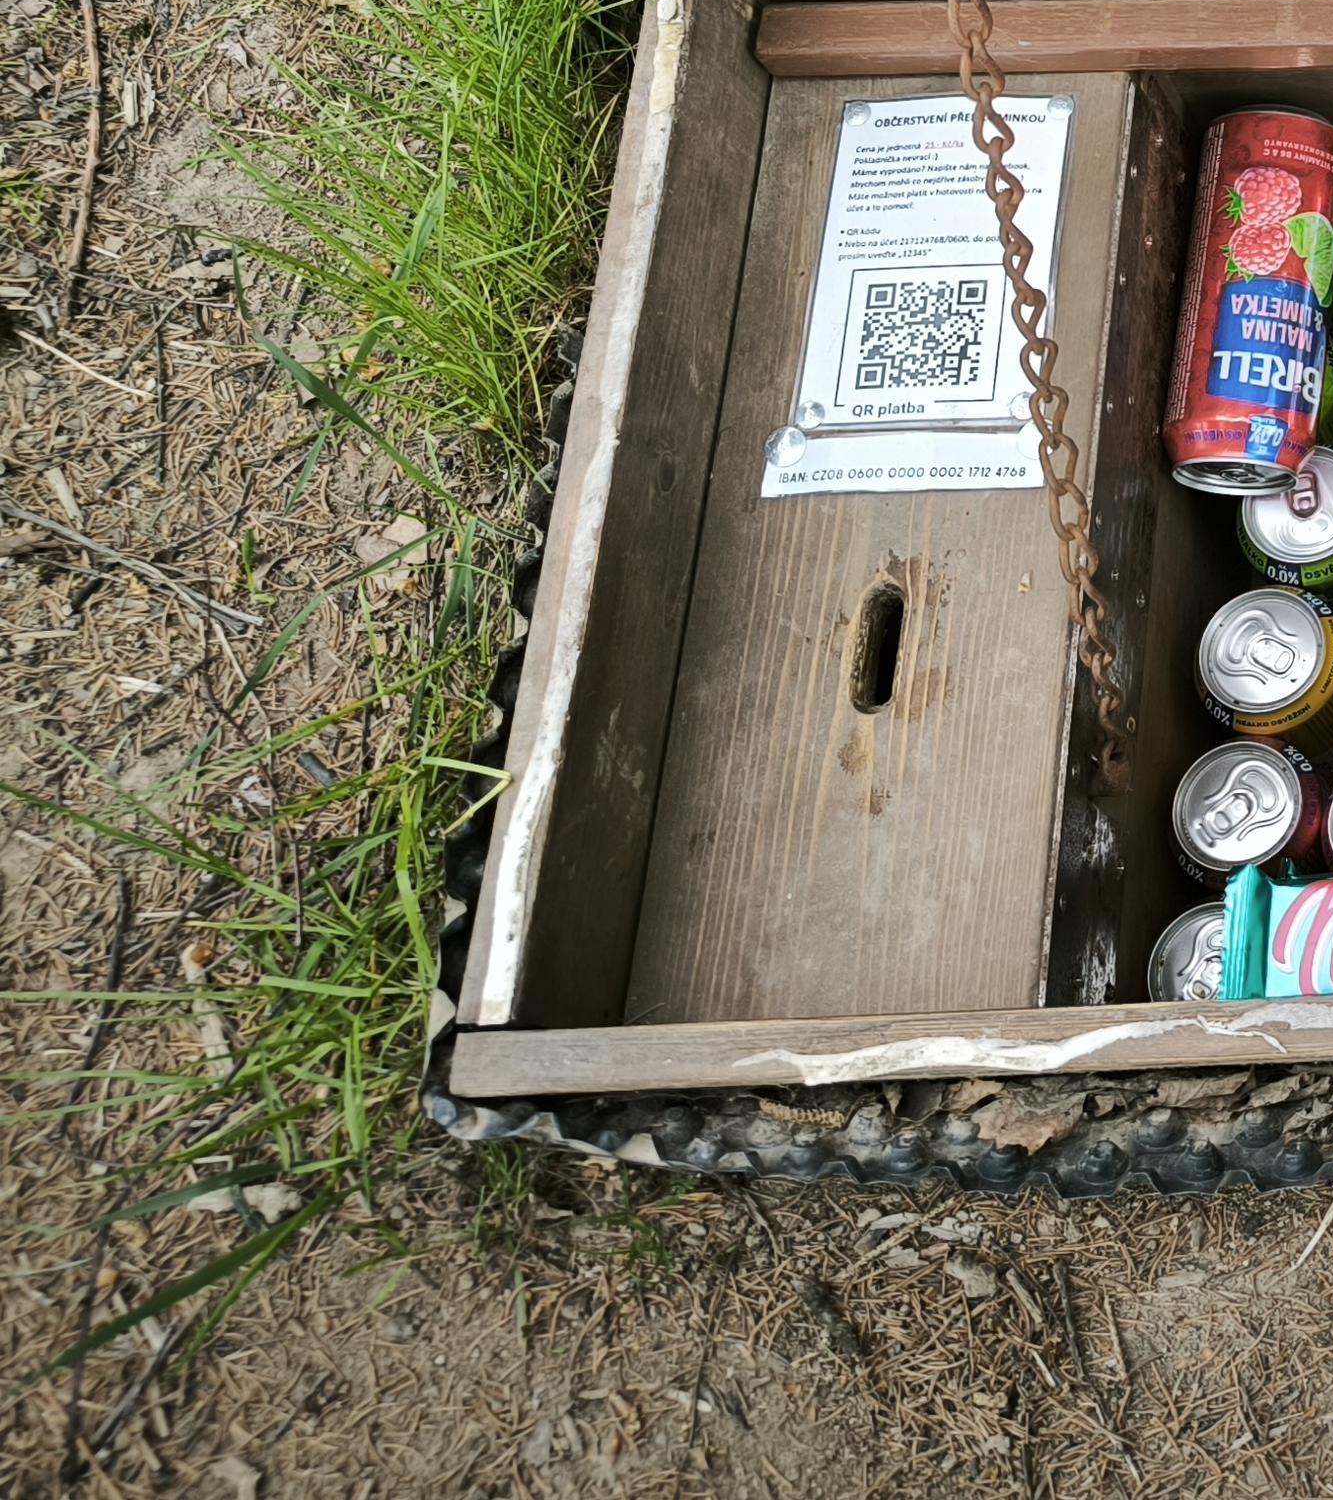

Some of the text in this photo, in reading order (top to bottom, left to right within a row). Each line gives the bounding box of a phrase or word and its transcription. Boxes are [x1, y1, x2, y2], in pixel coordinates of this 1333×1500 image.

[875, 111, 948, 128] OBČERSTVENÍ
[950, 111, 974, 123] PŘE
[856, 145, 876, 154] Cena
[852, 168, 877, 177] Máme
[1231, 293, 1323, 332] & LIMETKA
[1241, 318, 1313, 352] MALINA
[851, 402, 925, 418] QR platba
[778, 471, 808, 484] IBAN:
[848, 467, 883, 479] 0600
[888, 467, 925, 478] 0000
[929, 466, 964, 478] 0002
[968, 466, 991, 477] 1712
[995, 465, 1026, 477] 4768
[1267, 565, 1299, 585] 0.0%
